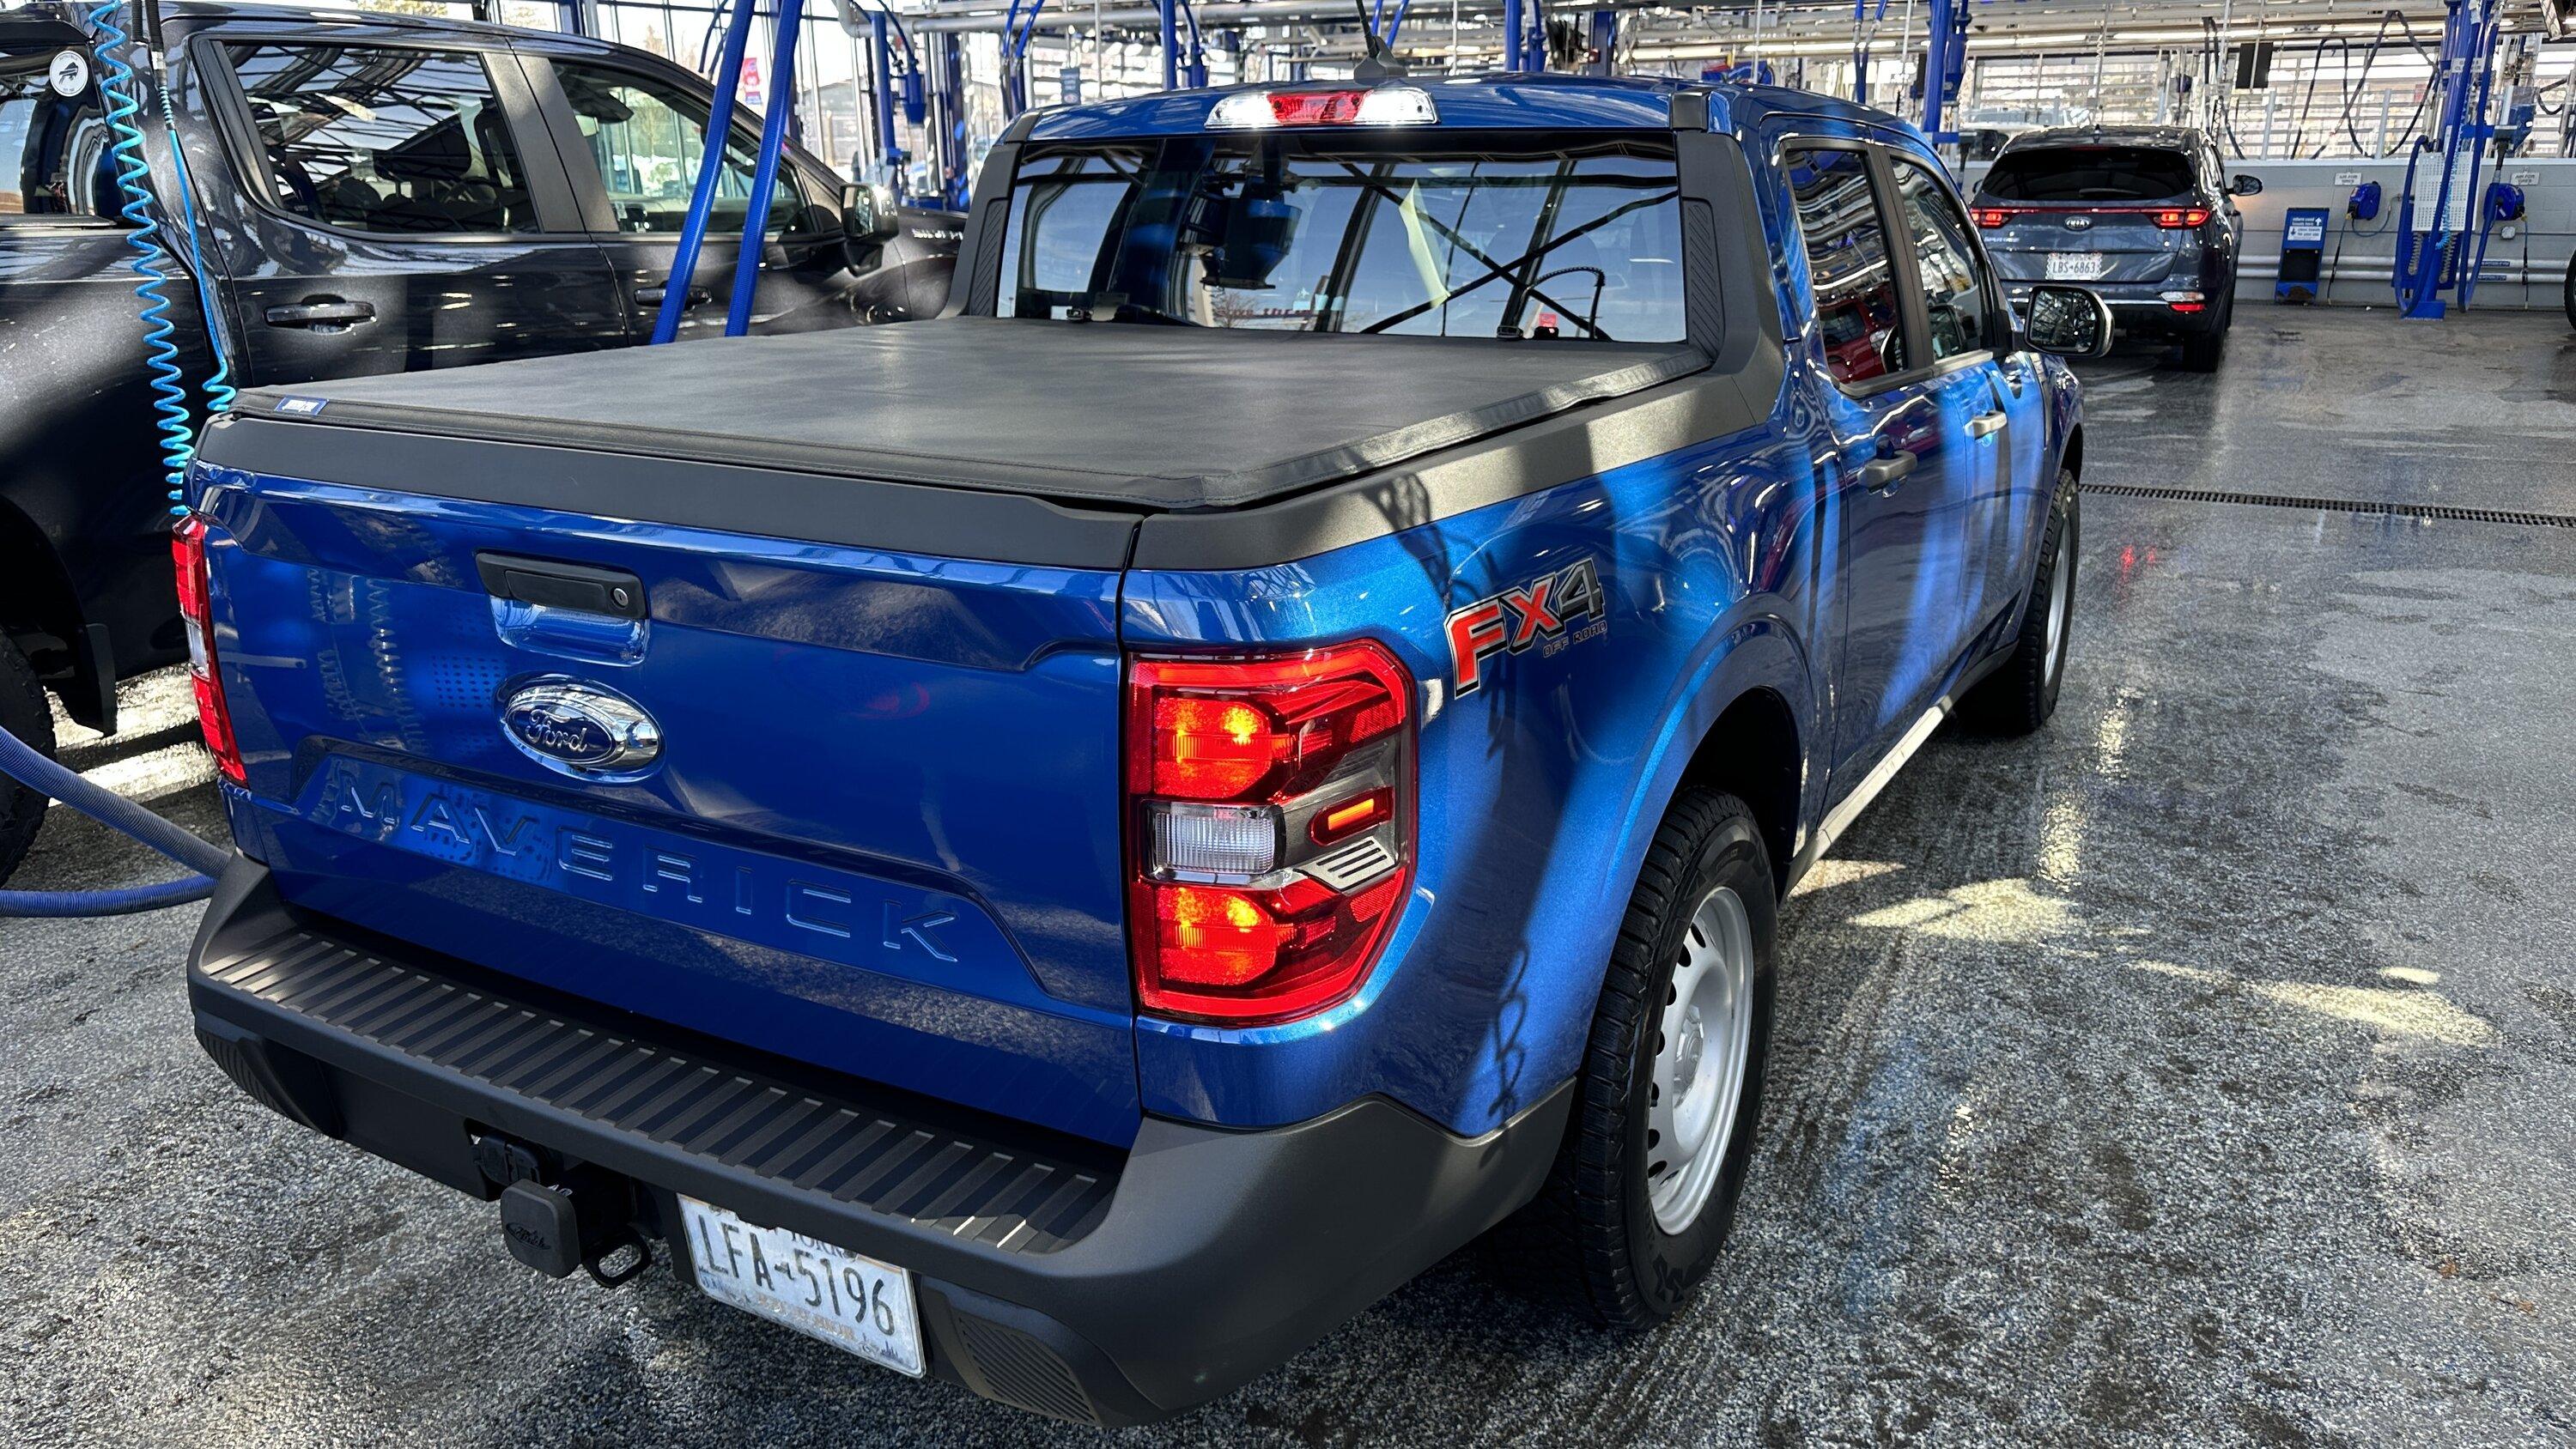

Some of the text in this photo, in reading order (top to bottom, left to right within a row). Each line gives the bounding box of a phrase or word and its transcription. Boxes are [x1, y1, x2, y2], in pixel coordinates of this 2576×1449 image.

[1443, 557, 1606, 700] FX4
[1542, 621, 1608, 658] OFF ROAD
[525, 709, 587, 753] Ford
[339, 777, 959, 963] MAVERICK
